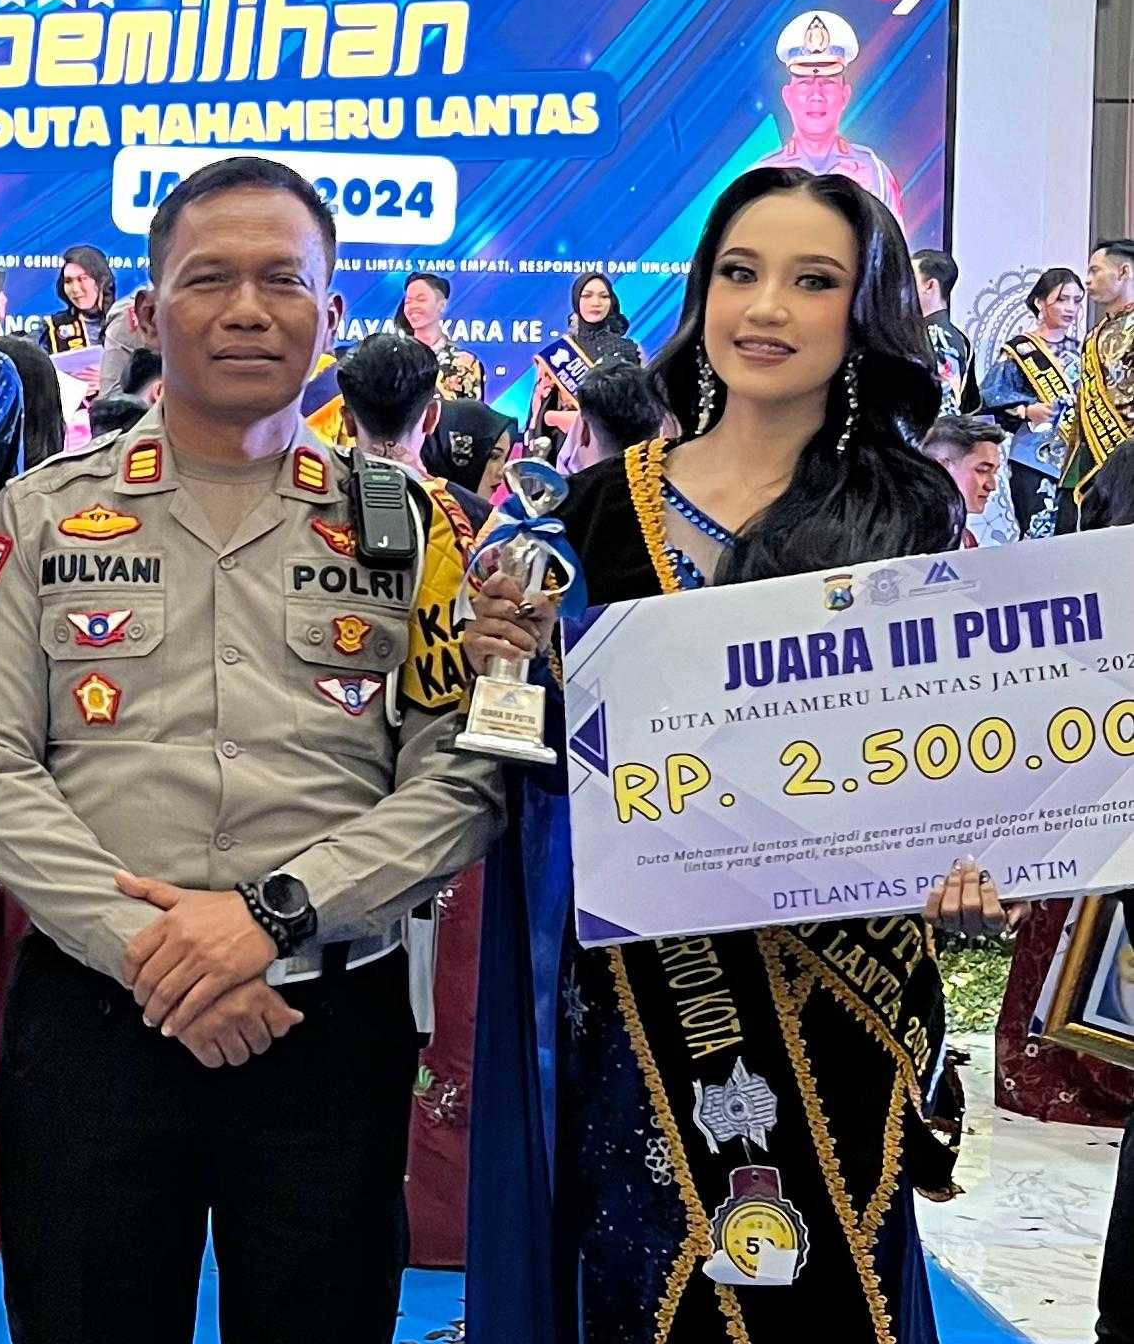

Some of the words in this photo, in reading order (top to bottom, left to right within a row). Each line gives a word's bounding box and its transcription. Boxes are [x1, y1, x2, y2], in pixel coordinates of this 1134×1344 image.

[121, 97, 404, 146] MAHAMERU
[416, 92, 600, 138] LANTAS
[133, 170, 182, 208] JA
[315, 177, 434, 218] 2024
[24, 255, 65, 269] GENE
[335, 258, 361, 270] ALU
[366, 259, 413, 271] LINTAS
[417, 259, 456, 271] YANG
[460, 260, 514, 273] EMPATI,
[519, 260, 603, 273] RESPONSIVE
[607, 261, 636, 273] DAN
[642, 261, 692, 273] UNGGU
[512, 320, 543, 342] KE
[42, 554, 161, 585] MULYANI
[293, 565, 404, 600] POLRI
[724, 627, 873, 691] JUARA
[889, 618, 937, 668] III
[954, 592, 1103, 659] PUTRI
[650, 711, 715, 734] DUTA
[724, 689, 871, 724] MAHAMERU
[881, 674, 981, 702] LANTAS
[993, 663, 1070, 692] JATIM
[1097, 652, 1134, 673] 202
[613, 753, 736, 824] RP.
[780, 699, 1134, 796] 2.500.00
[637, 853, 670, 866] Duta
[674, 845, 749, 862] Mahameru
[752, 838, 798, 853] lantas
[801, 830, 861, 847] menjadi
[863, 823, 926, 842] generasi
[929, 818, 971, 833] muda
[975, 810, 1034, 830] pelopor
[726, 856, 762, 870] yang
[765, 848, 819, 866] empati,
[822, 838, 901, 860] responsive
[906, 835, 934, 848] dan
[938, 829, 988, 846] unggul
[992, 824, 1039, 839] dalam
[1043, 815, 1098, 832] berlalu
[773, 879, 907, 910] DITLANTAS
[1004, 859, 1078, 885] JATIM
[676, 989, 744, 1059] KOTA
